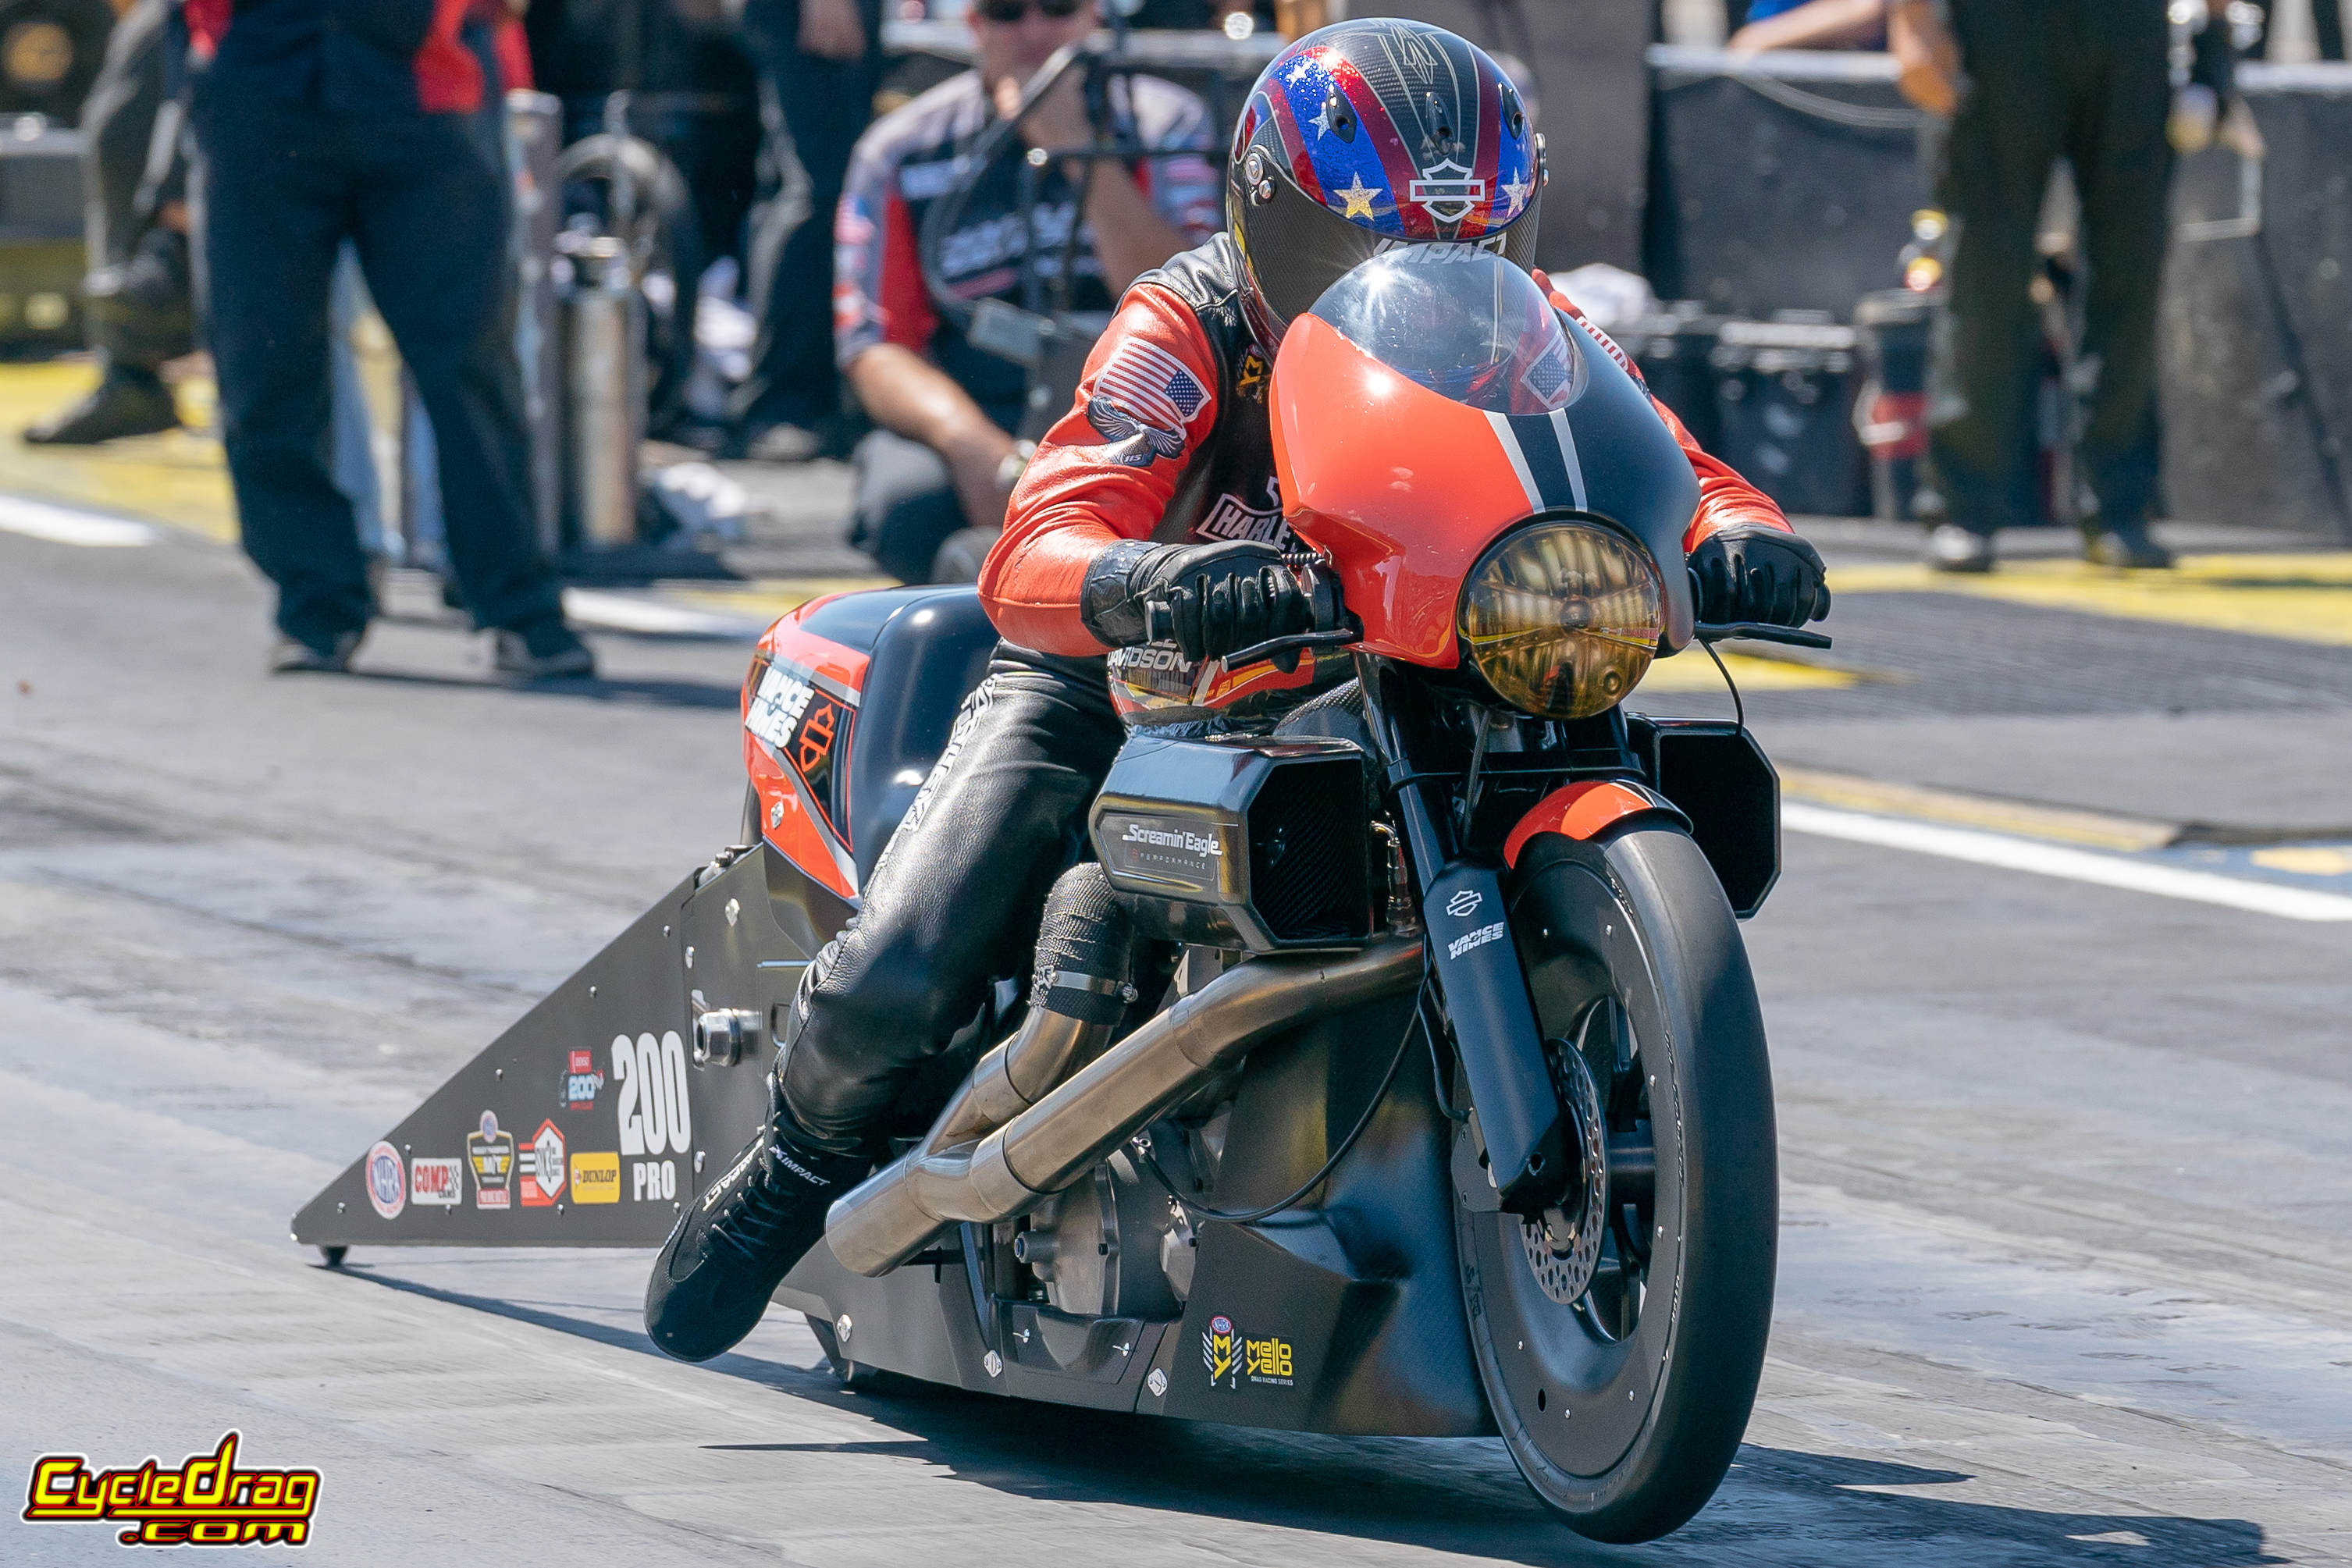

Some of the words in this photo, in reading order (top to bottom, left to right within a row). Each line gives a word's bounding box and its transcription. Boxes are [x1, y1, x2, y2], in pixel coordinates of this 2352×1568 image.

[1373, 232, 1508, 264] IMPACT
[1212, 504, 1298, 553] HARLE
[757, 665, 815, 720] VANCE
[745, 695, 798, 748] HINES
[1447, 922, 1505, 952] VANCE
[1450, 930, 1503, 960] HINES
[568, 1075, 595, 1101] 200
[610, 1030, 692, 1156] 200
[415, 1165, 449, 1193] COMP
[582, 1170, 617, 1182] DUNLOP
[632, 1160, 677, 1202] PRO
[781, 1157, 831, 1187] IMPACT
